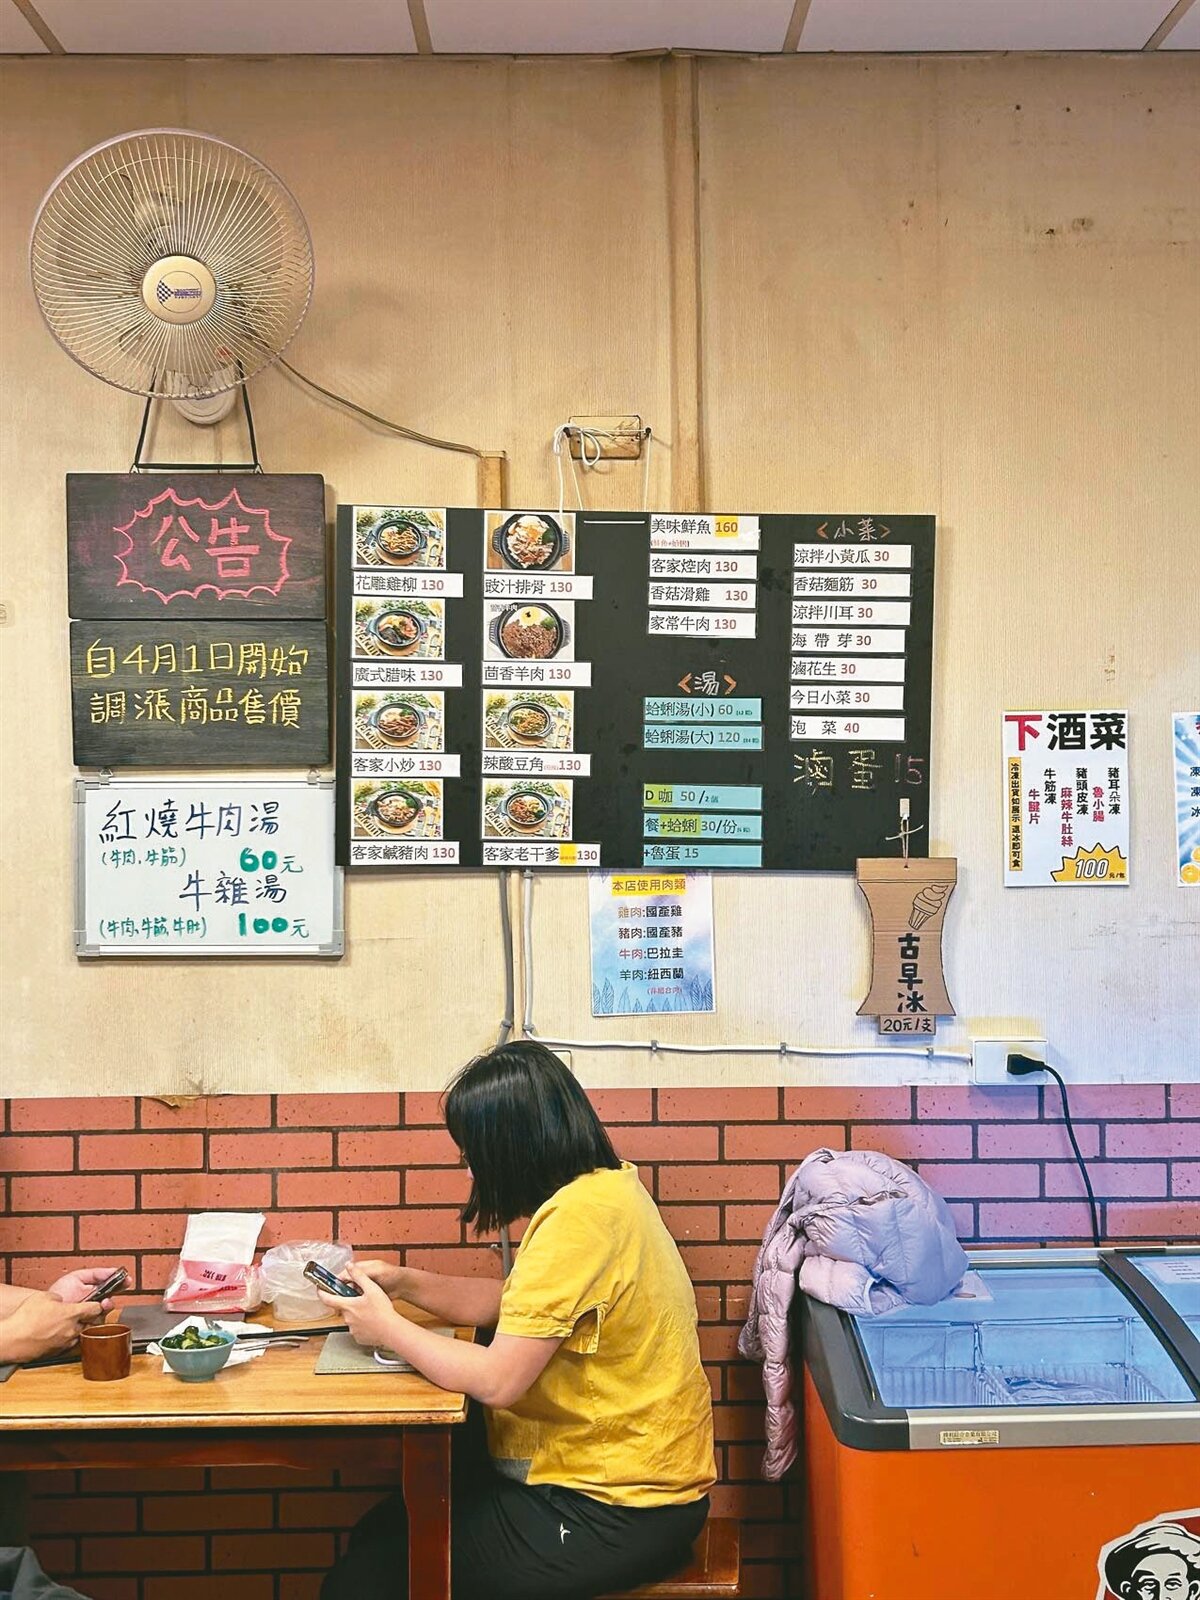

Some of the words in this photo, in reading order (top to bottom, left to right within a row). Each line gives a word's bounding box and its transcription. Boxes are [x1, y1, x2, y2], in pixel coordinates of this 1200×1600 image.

[651, 518, 712, 534] 美味鮮魚
[715, 521, 738, 533] 160
[152, 516, 260, 578] 公告
[794, 549, 870, 564] 涼拌小黃瓜
[874, 550, 890, 562] 30
[651, 558, 711, 574] 客家焢肉
[715, 561, 738, 572] 130
[355, 575, 417, 592] 花雕雞柳
[421, 579, 444, 591] 130
[485, 578, 546, 595] 豉汁排骨
[549, 581, 573, 593] 130
[794, 576, 855, 592] 香菇麵筋
[861, 579, 878, 590] 30
[650, 586, 710, 602] 香菇滑雞
[725, 590, 748, 601] 130
[793, 605, 854, 620] 涼拌川耳
[857, 607, 873, 619] 30
[650, 615, 710, 631] 家常牛肉
[714, 619, 737, 630] 130
[856, 635, 872, 646] 30
[86, 639, 308, 679] 自4月1日開始
[354, 667, 416, 683] 廣式腊味
[420, 669, 443, 681] 130
[484, 666, 544, 682] 茴香羊肉
[549, 668, 572, 680] 130
[791, 661, 837, 676] 滷花生
[840, 663, 857, 675] 30
[791, 689, 851, 705] 今日小菜
[854, 692, 870, 703] 30
[90, 685, 302, 729] 調漲商品售價
[645, 702, 714, 717] 蛤蜊湯(小)
[718, 704, 733, 715] 60
[844, 722, 860, 734] 40
[1005, 713, 1126, 751] 下酒菜
[645, 729, 714, 745] 蛤蜊湯(大)
[718, 731, 740, 743] 120
[353, 757, 416, 773] 客家小炒
[419, 760, 442, 771] 130
[484, 756, 544, 772] 辣酸豆角
[559, 759, 582, 771] 130
[895, 752, 924, 785] 15
[1044, 768, 1057, 805] 牛筋凍
[1076, 767, 1089, 815] 豬頭皮凍
[1107, 767, 1121, 815] 豬耳朵凍
[680, 791, 695, 802] 50
[1092, 786, 1105, 823] 魯小腸
[98, 799, 280, 843] 紅燒牛肉湯
[352, 845, 428, 861] 客家鹹豬肉
[433, 847, 456, 859] 130
[484, 846, 560, 862] 客家老干爹
[577, 850, 598, 861] 130
[684, 848, 699, 859] 15
[1075, 857, 1110, 879] 100
[179, 870, 287, 911] 牛雜湯
[612, 878, 686, 892] 本店使用肉類
[898, 932, 928, 1013] 古早冰
